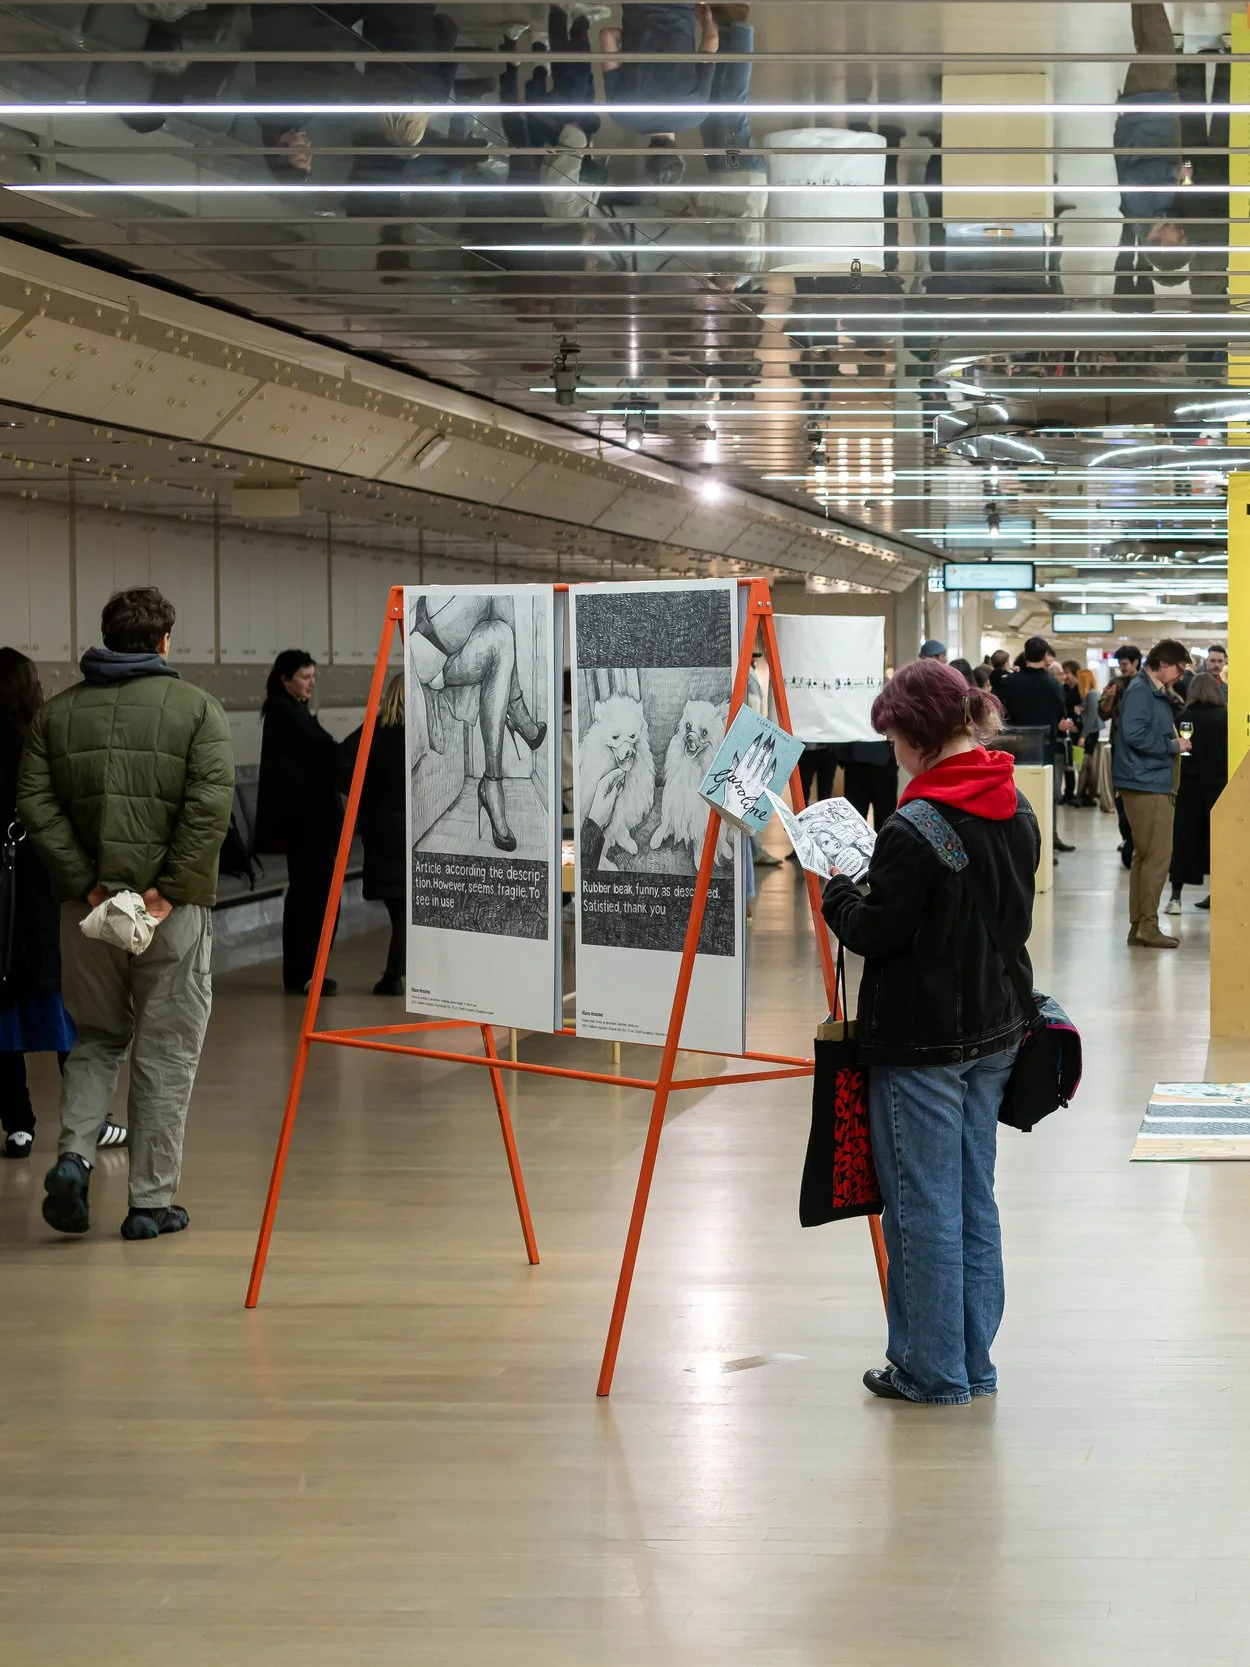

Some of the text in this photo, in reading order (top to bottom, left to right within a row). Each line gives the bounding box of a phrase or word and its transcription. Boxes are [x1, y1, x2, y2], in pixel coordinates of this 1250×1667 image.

[415, 861, 544, 886] Article according the descrip-
[468, 883, 494, 895] seems
[498, 884, 528, 900] fragile.
[529, 887, 540, 899] To
[582, 880, 721, 899] Rubber beak, funny, as desced.
[415, 895, 455, 908] see in use
[583, 900, 666, 917] Satisfied, thank you
